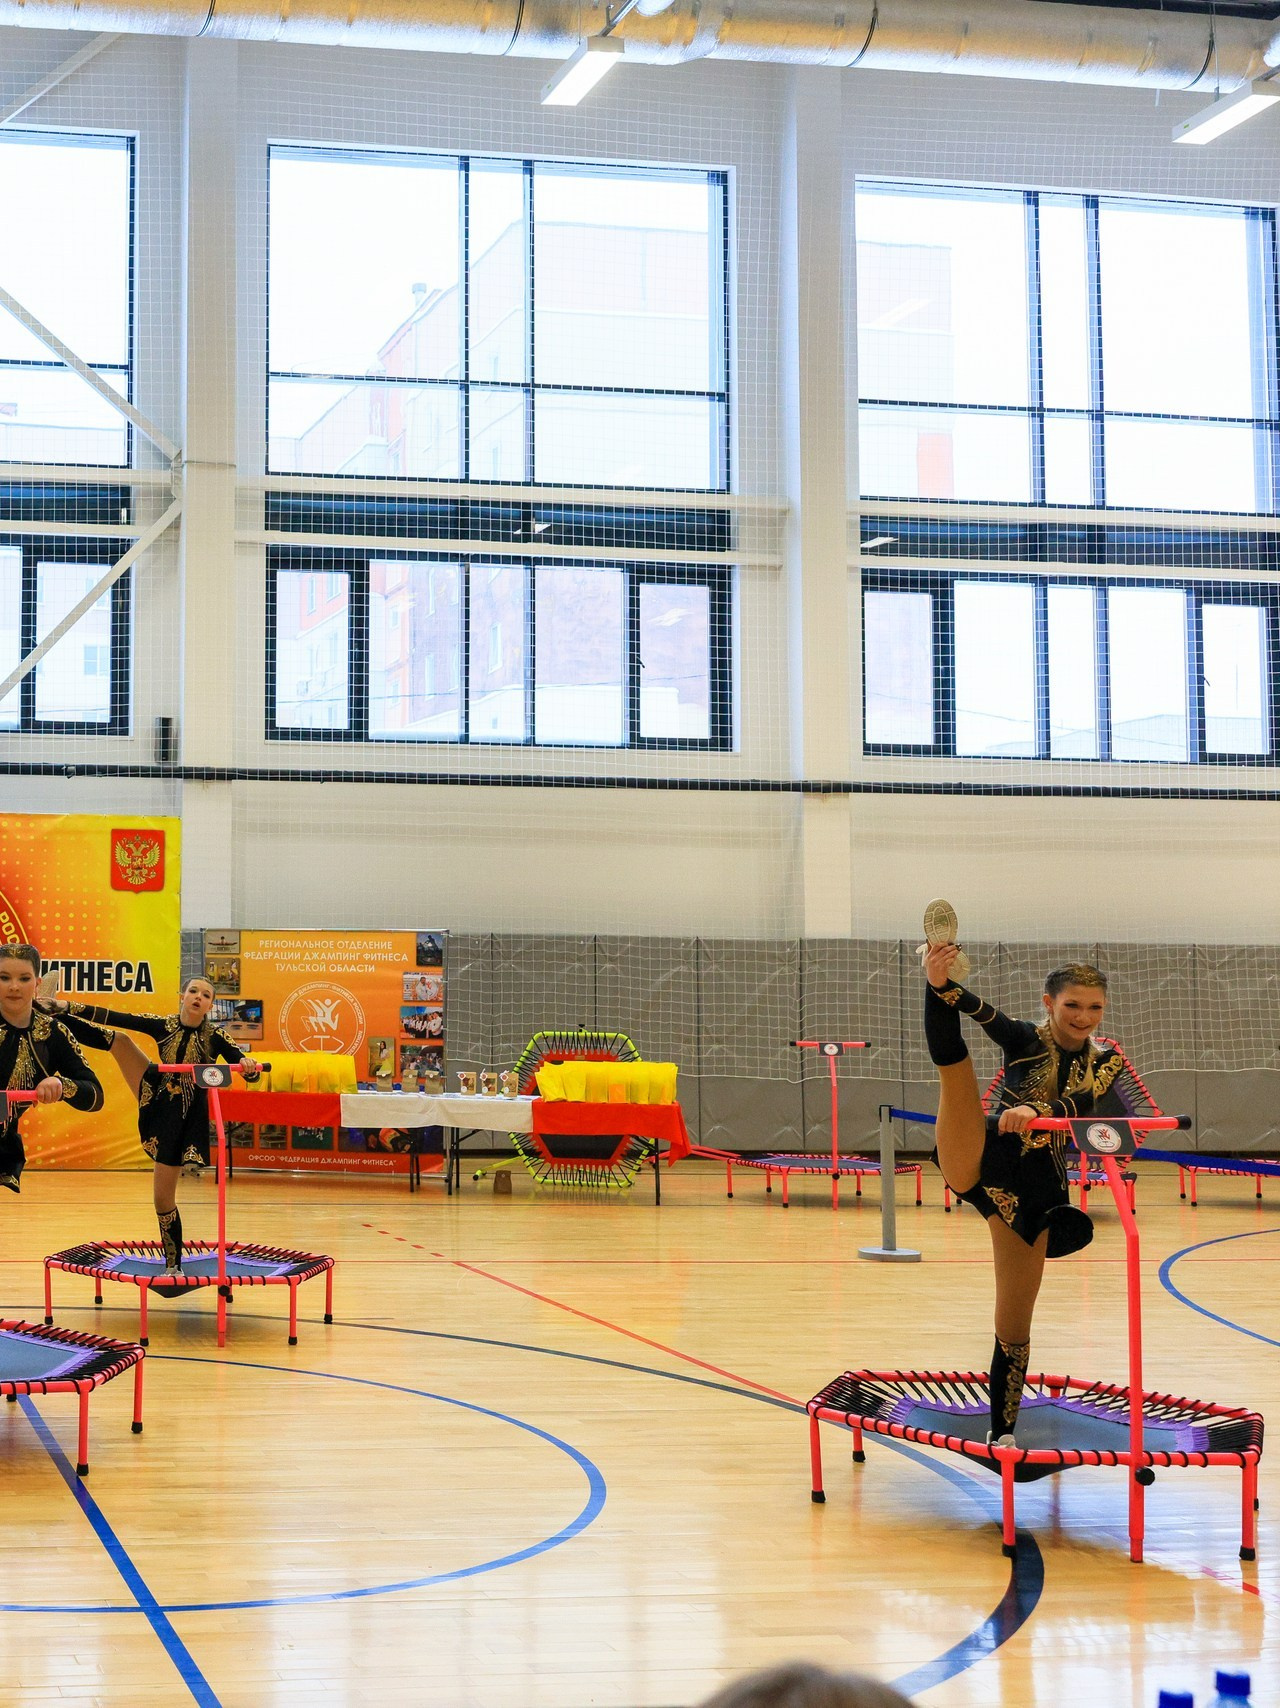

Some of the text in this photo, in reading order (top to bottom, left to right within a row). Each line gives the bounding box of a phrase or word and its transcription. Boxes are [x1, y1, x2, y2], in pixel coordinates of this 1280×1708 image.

[259, 939, 393, 950] РЕГИОНАЛЬНОЕ ОТДЕЛЕНИЕ
[243, 951, 409, 962] ФЕДЕРАЦИИ ДЖАМПИНГ ФИТНЕСА
[275, 962, 375, 973] ТУЛЬСКОЙ ОБЛАСТИ
[41, 960, 155, 993] ИТНЕСА
[320, 1157, 361, 1165] ДЖАМПИНГ
[361, 1158, 397, 1166] ФИТНЕСА"
